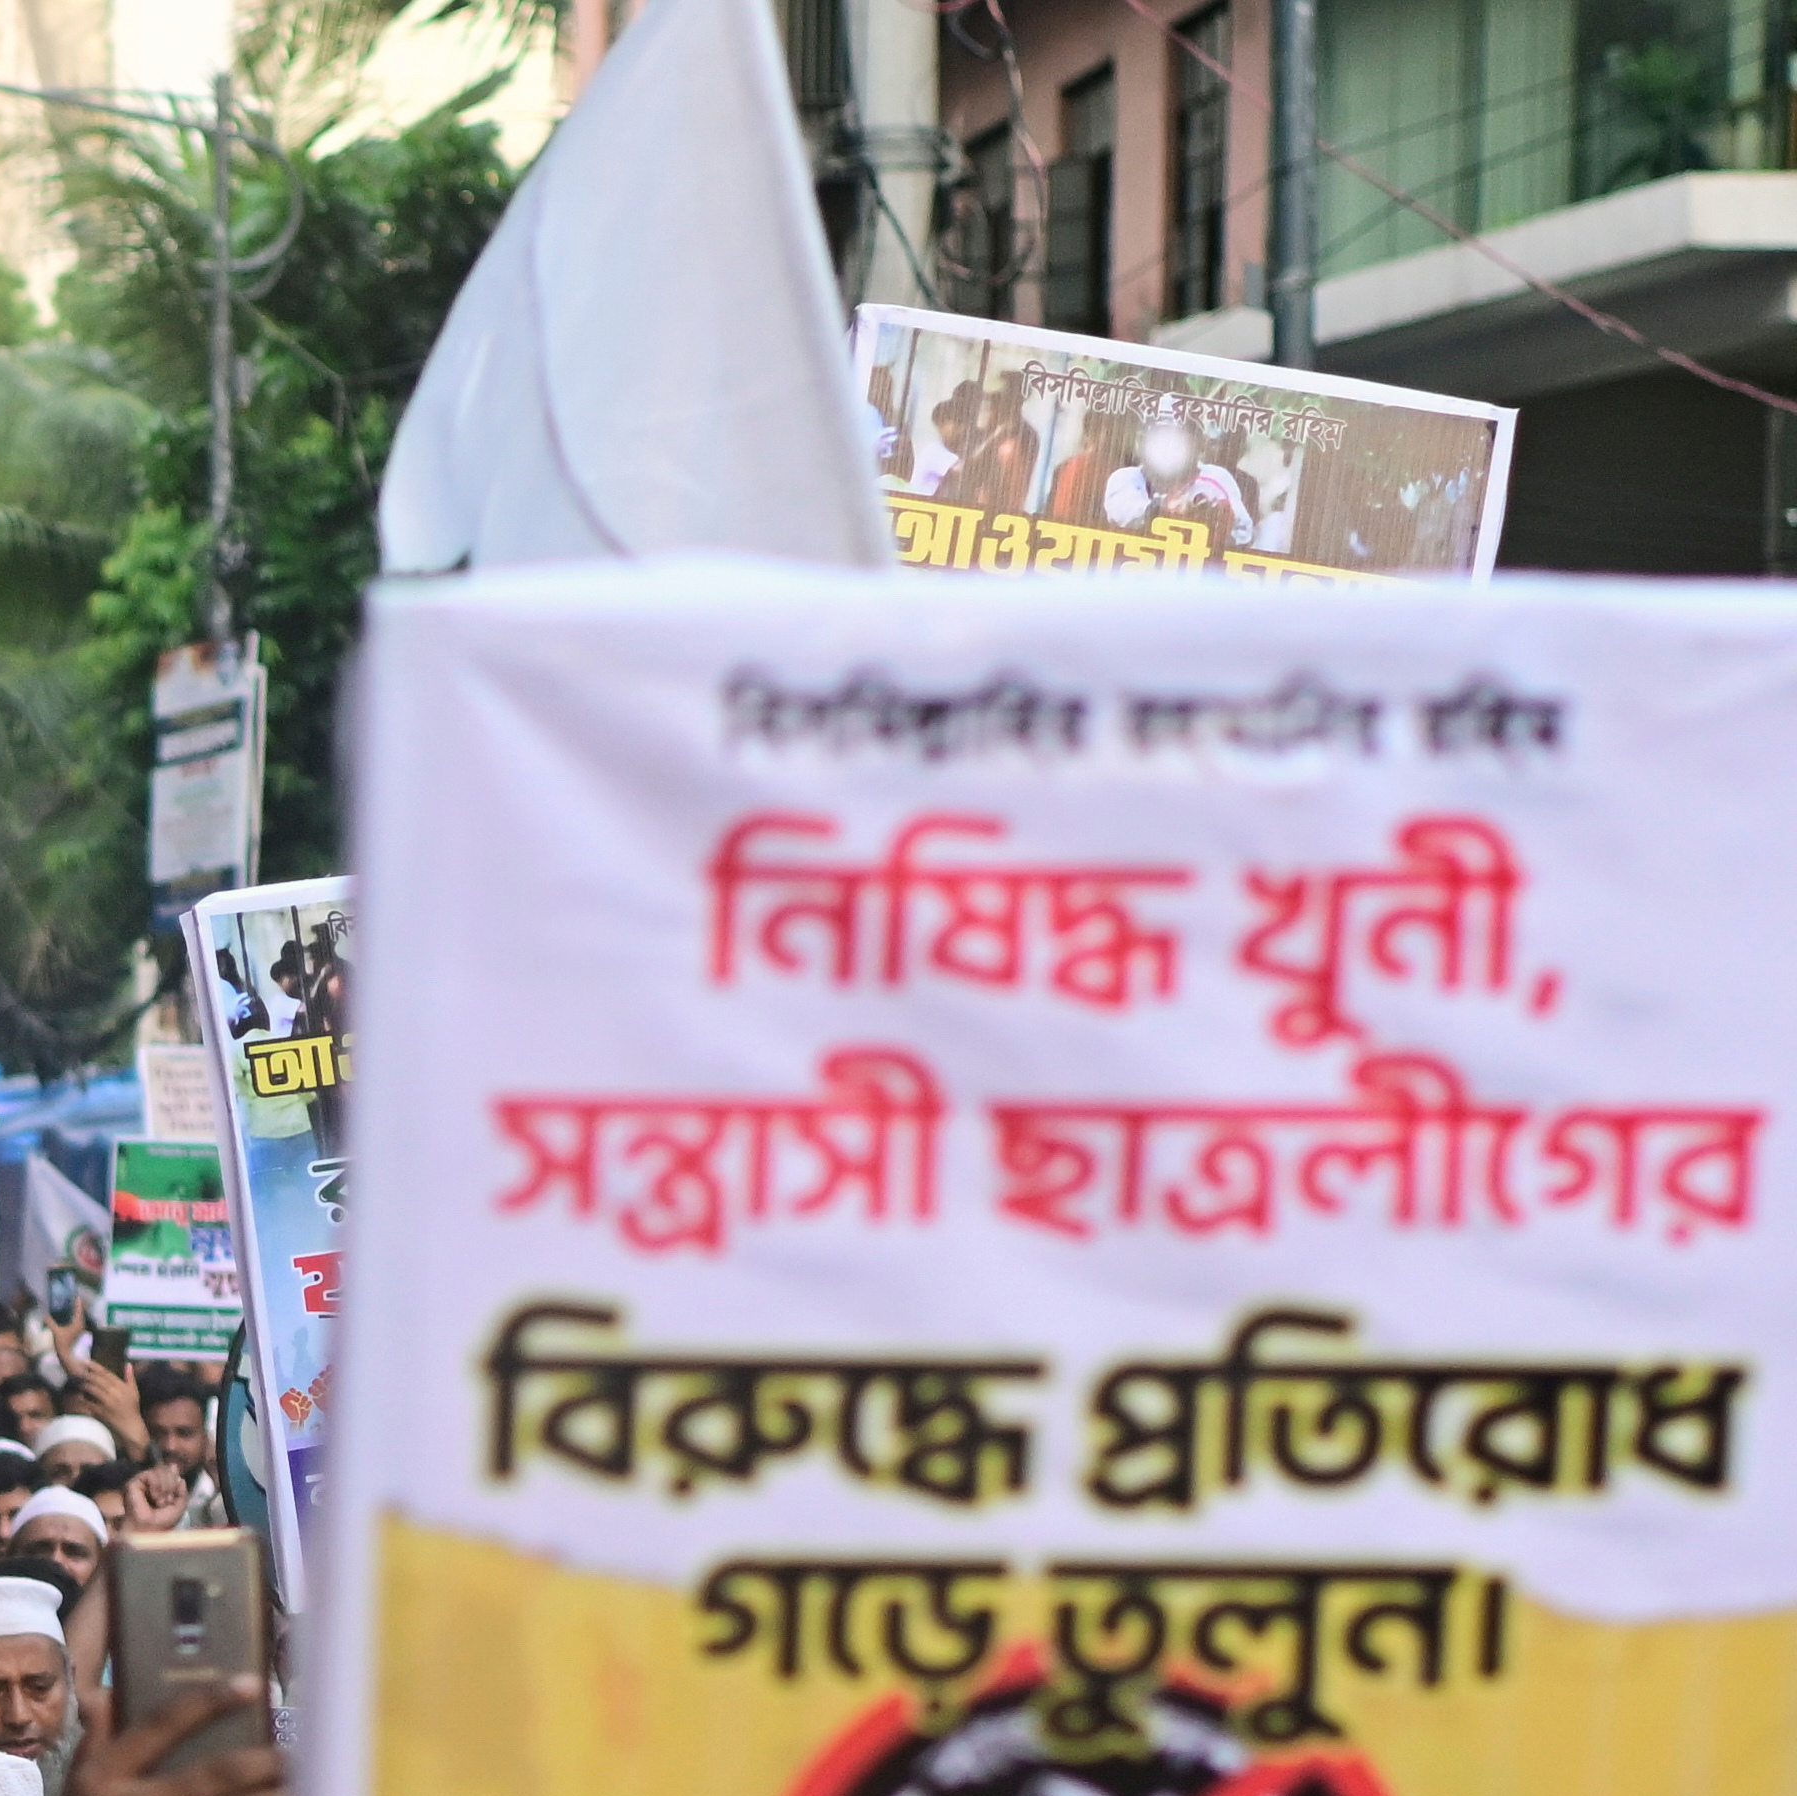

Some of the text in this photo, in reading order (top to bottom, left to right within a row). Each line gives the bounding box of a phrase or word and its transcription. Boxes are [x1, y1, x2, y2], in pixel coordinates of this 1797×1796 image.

[1022, 361, 1347, 452] বিসমিল্লাহির রহমানির রহিম
[704, 812, 1567, 1048] নিষিদ্ধ খুনী,
[488, 1046, 1769, 1258] সন্ত্রাসী ছাত্রলীগের
[476, 1296, 1754, 1513] বিরুদ্ধে প্রতিরোধ
[690, 1556, 1008, 1725] গড়ে
[1039, 1558, 1513, 1759] তুলুন।
